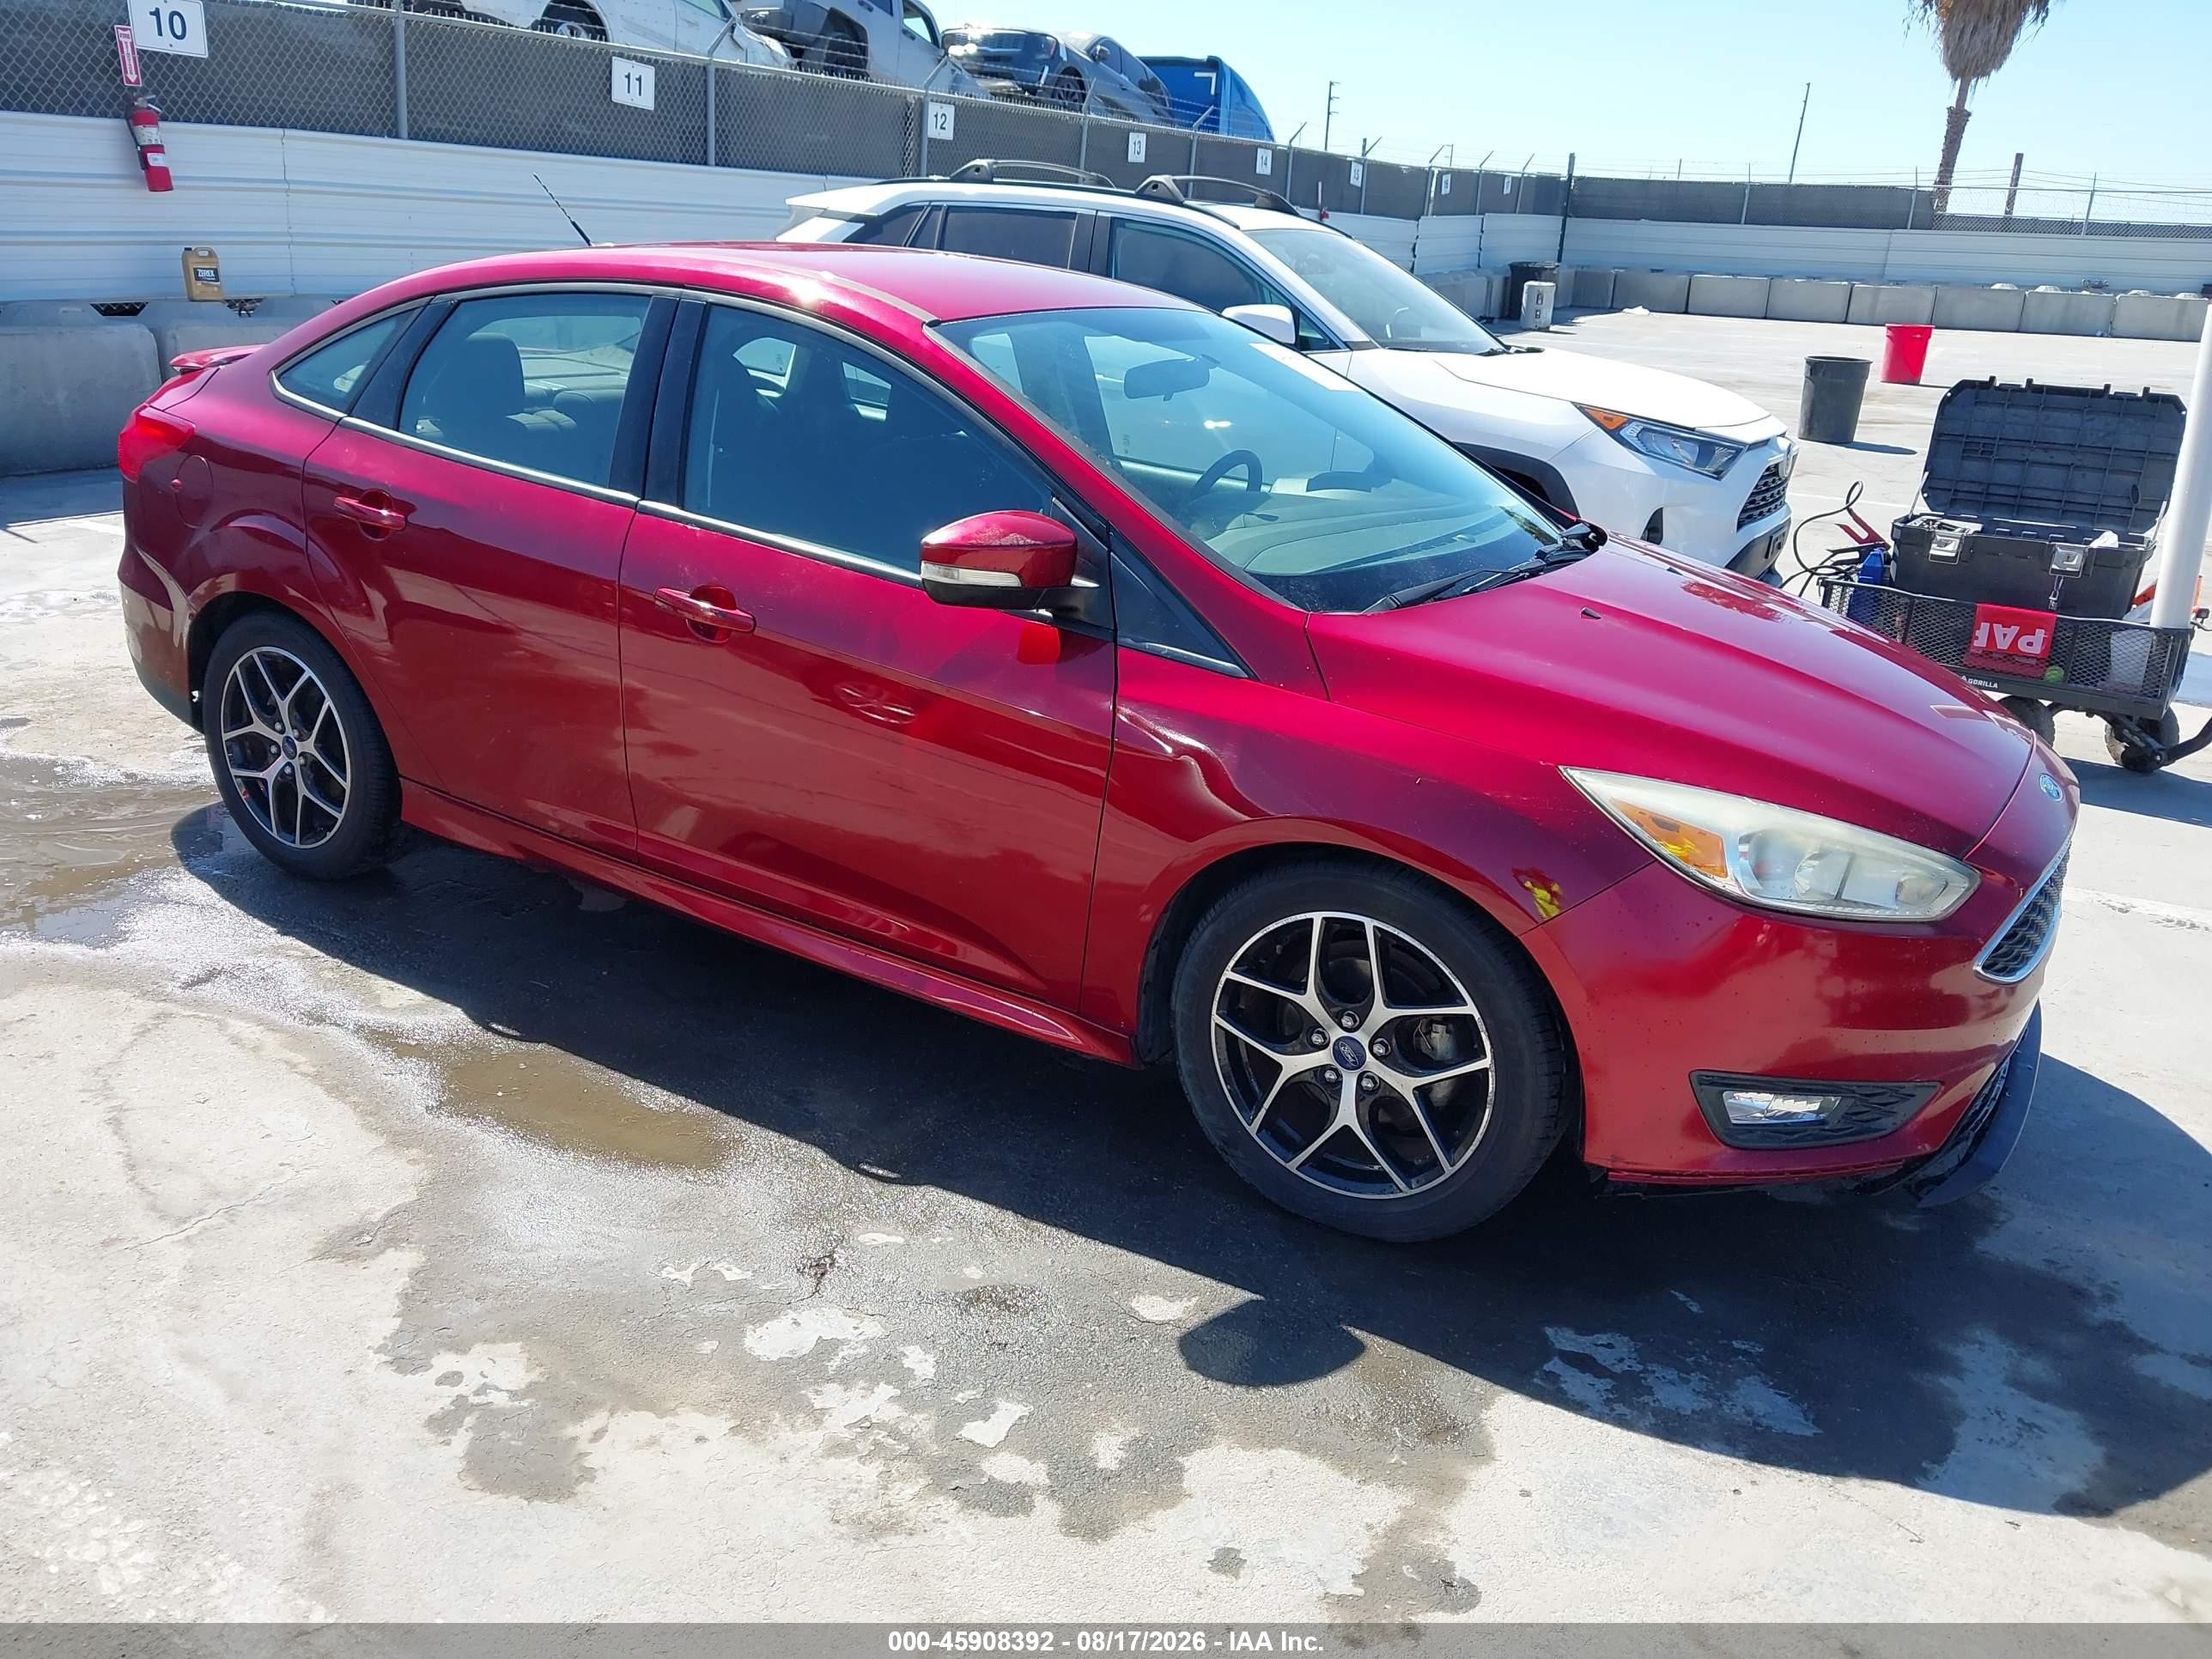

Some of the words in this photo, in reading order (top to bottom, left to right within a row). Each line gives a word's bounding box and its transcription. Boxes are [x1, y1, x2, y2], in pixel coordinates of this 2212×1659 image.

[149, 7, 187, 40] 10
[624, 72, 642, 96] 11
[933, 112, 947, 131] 12
[1133, 139, 1141, 155] 13
[198, 269, 216, 277] ZEREX
[1967, 678, 1998, 689] GORILLA
